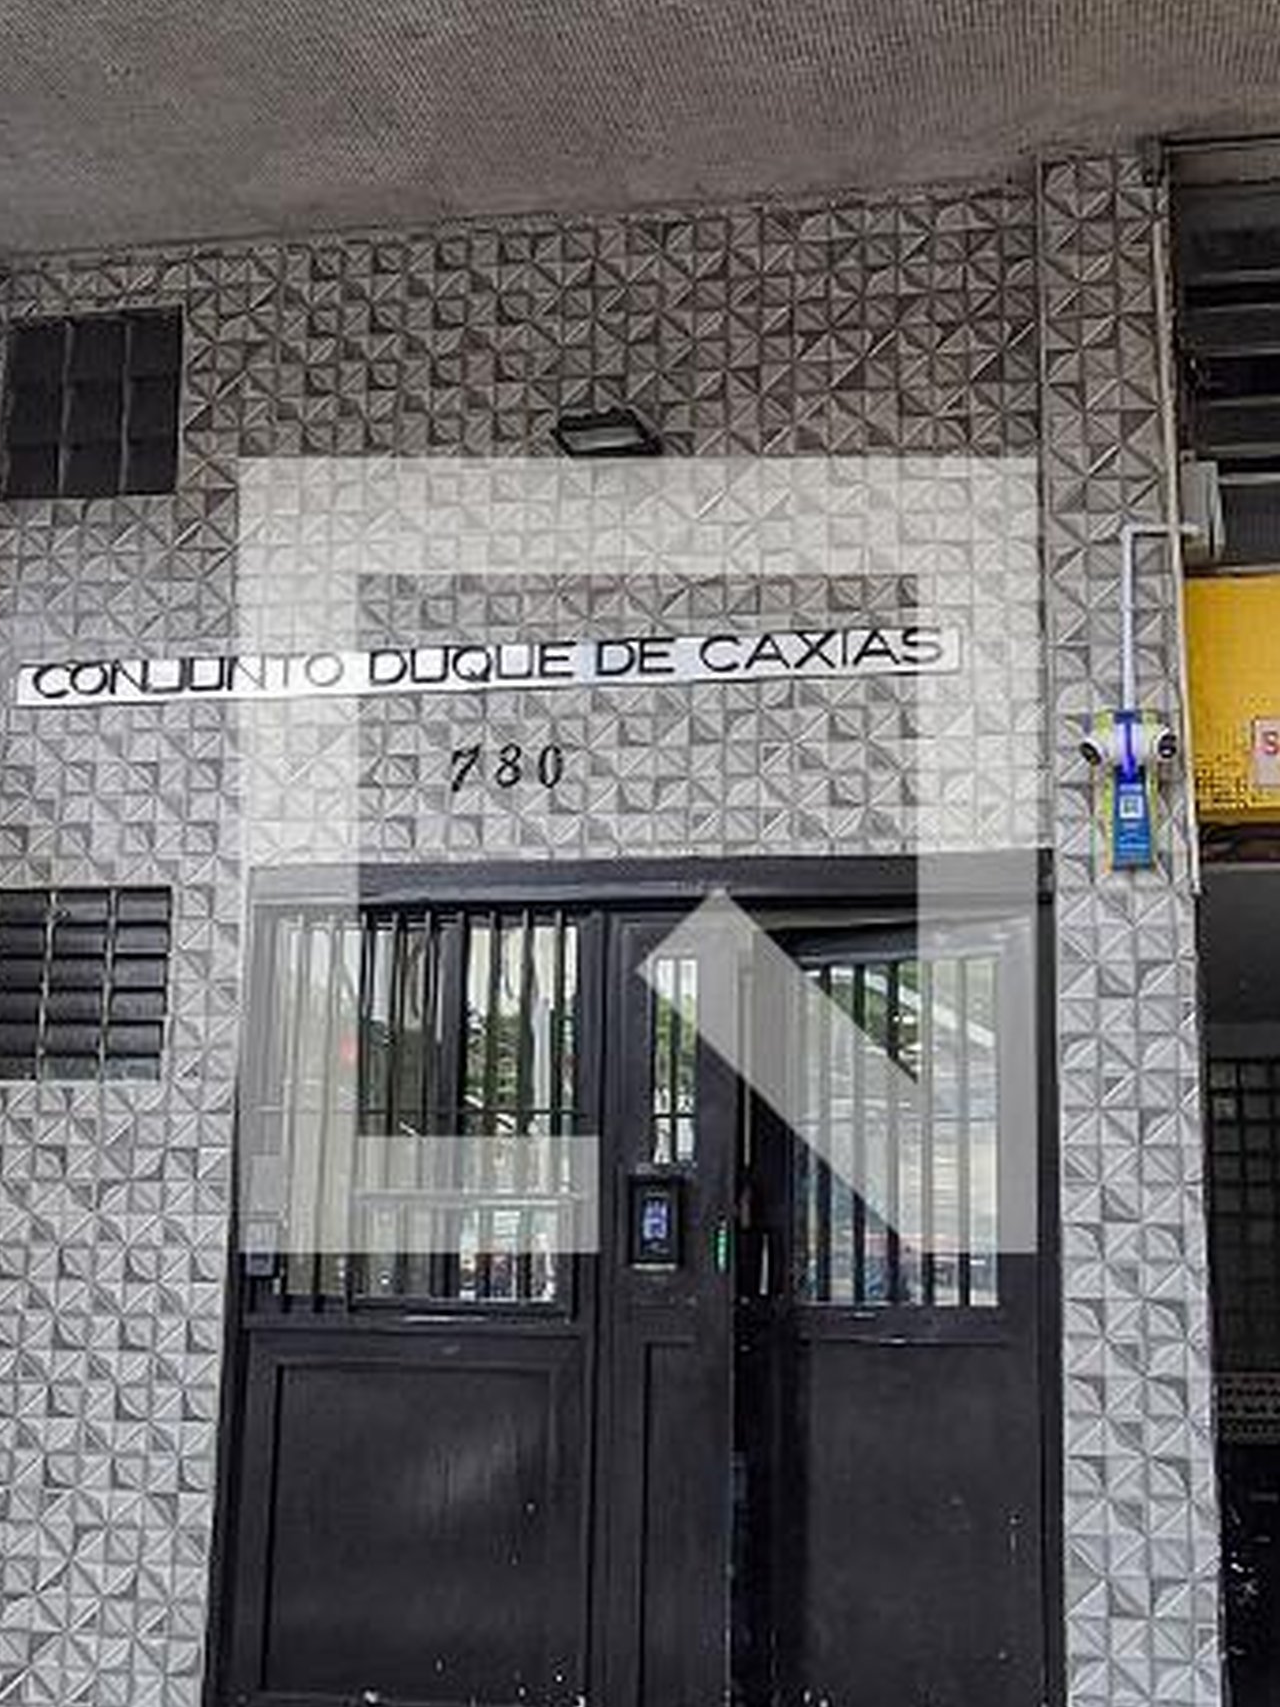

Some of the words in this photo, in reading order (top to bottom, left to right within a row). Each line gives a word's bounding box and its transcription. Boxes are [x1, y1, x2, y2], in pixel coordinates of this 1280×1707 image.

[32, 652, 345, 697] CONJUNTO
[368, 641, 576, 686] DUQUE
[595, 636, 676, 677] DE
[698, 626, 942, 672] CAXIAS
[450, 743, 564, 792] 780
